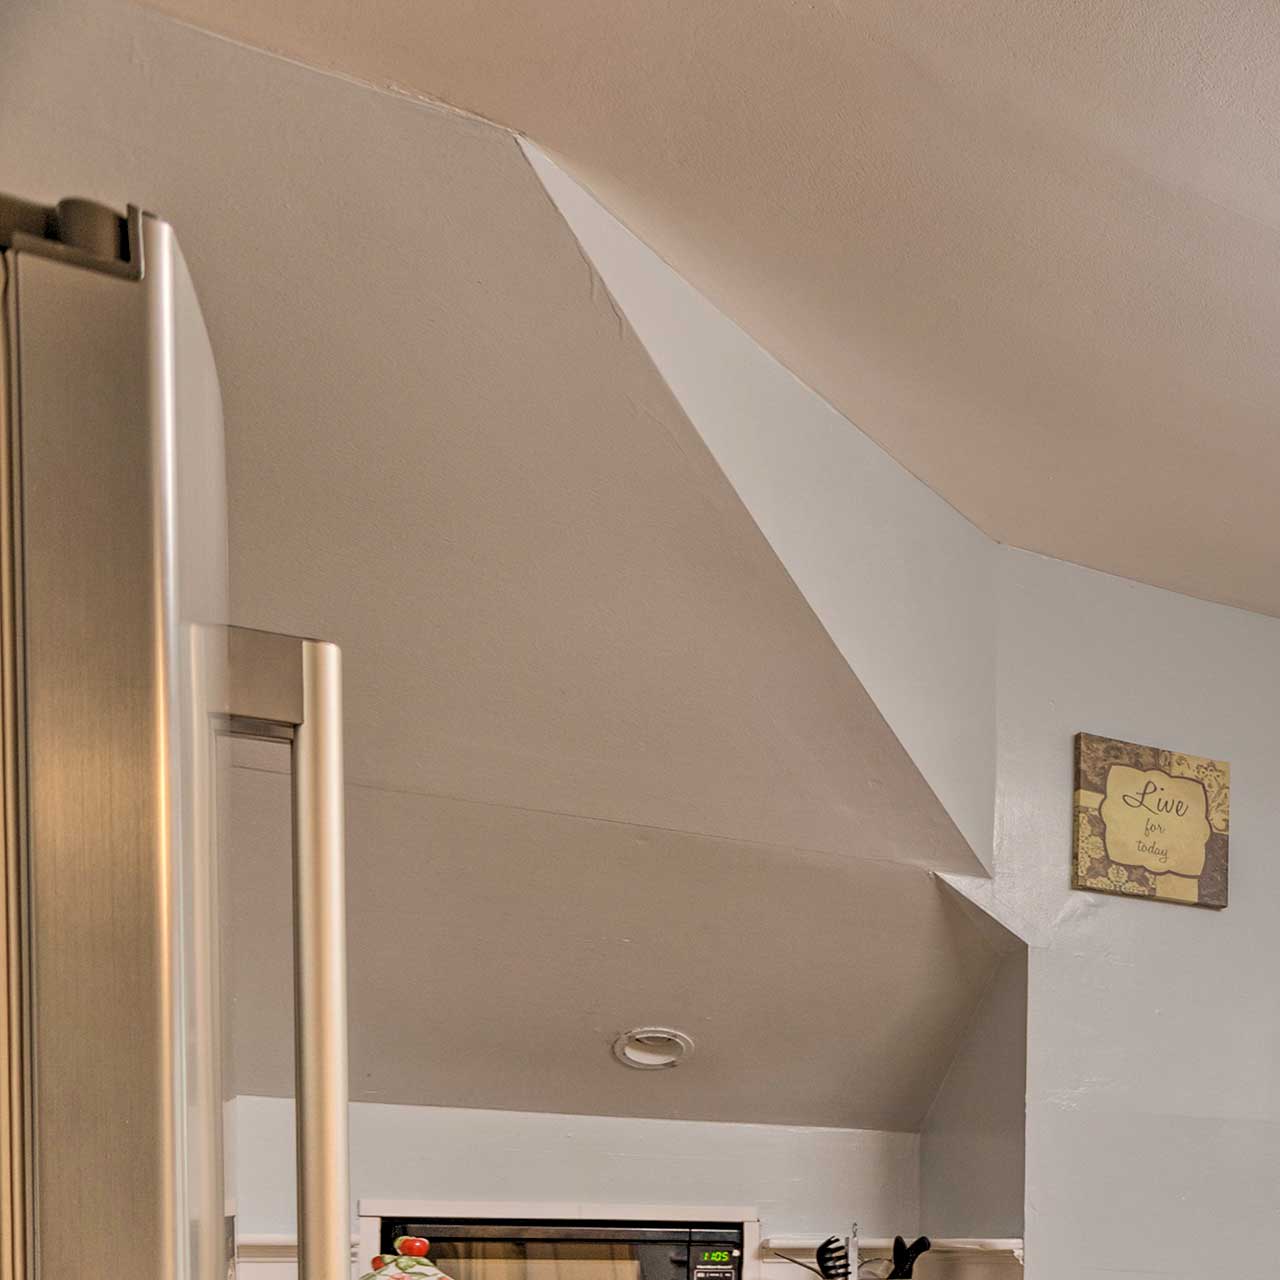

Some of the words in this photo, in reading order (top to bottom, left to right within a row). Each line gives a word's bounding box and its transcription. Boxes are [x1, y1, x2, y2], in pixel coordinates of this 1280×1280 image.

[1122, 780, 1189, 817] Live
[1144, 818, 1166, 836] for
[1136, 840, 1169, 863] today
[703, 1251, 729, 1262] 11:05
